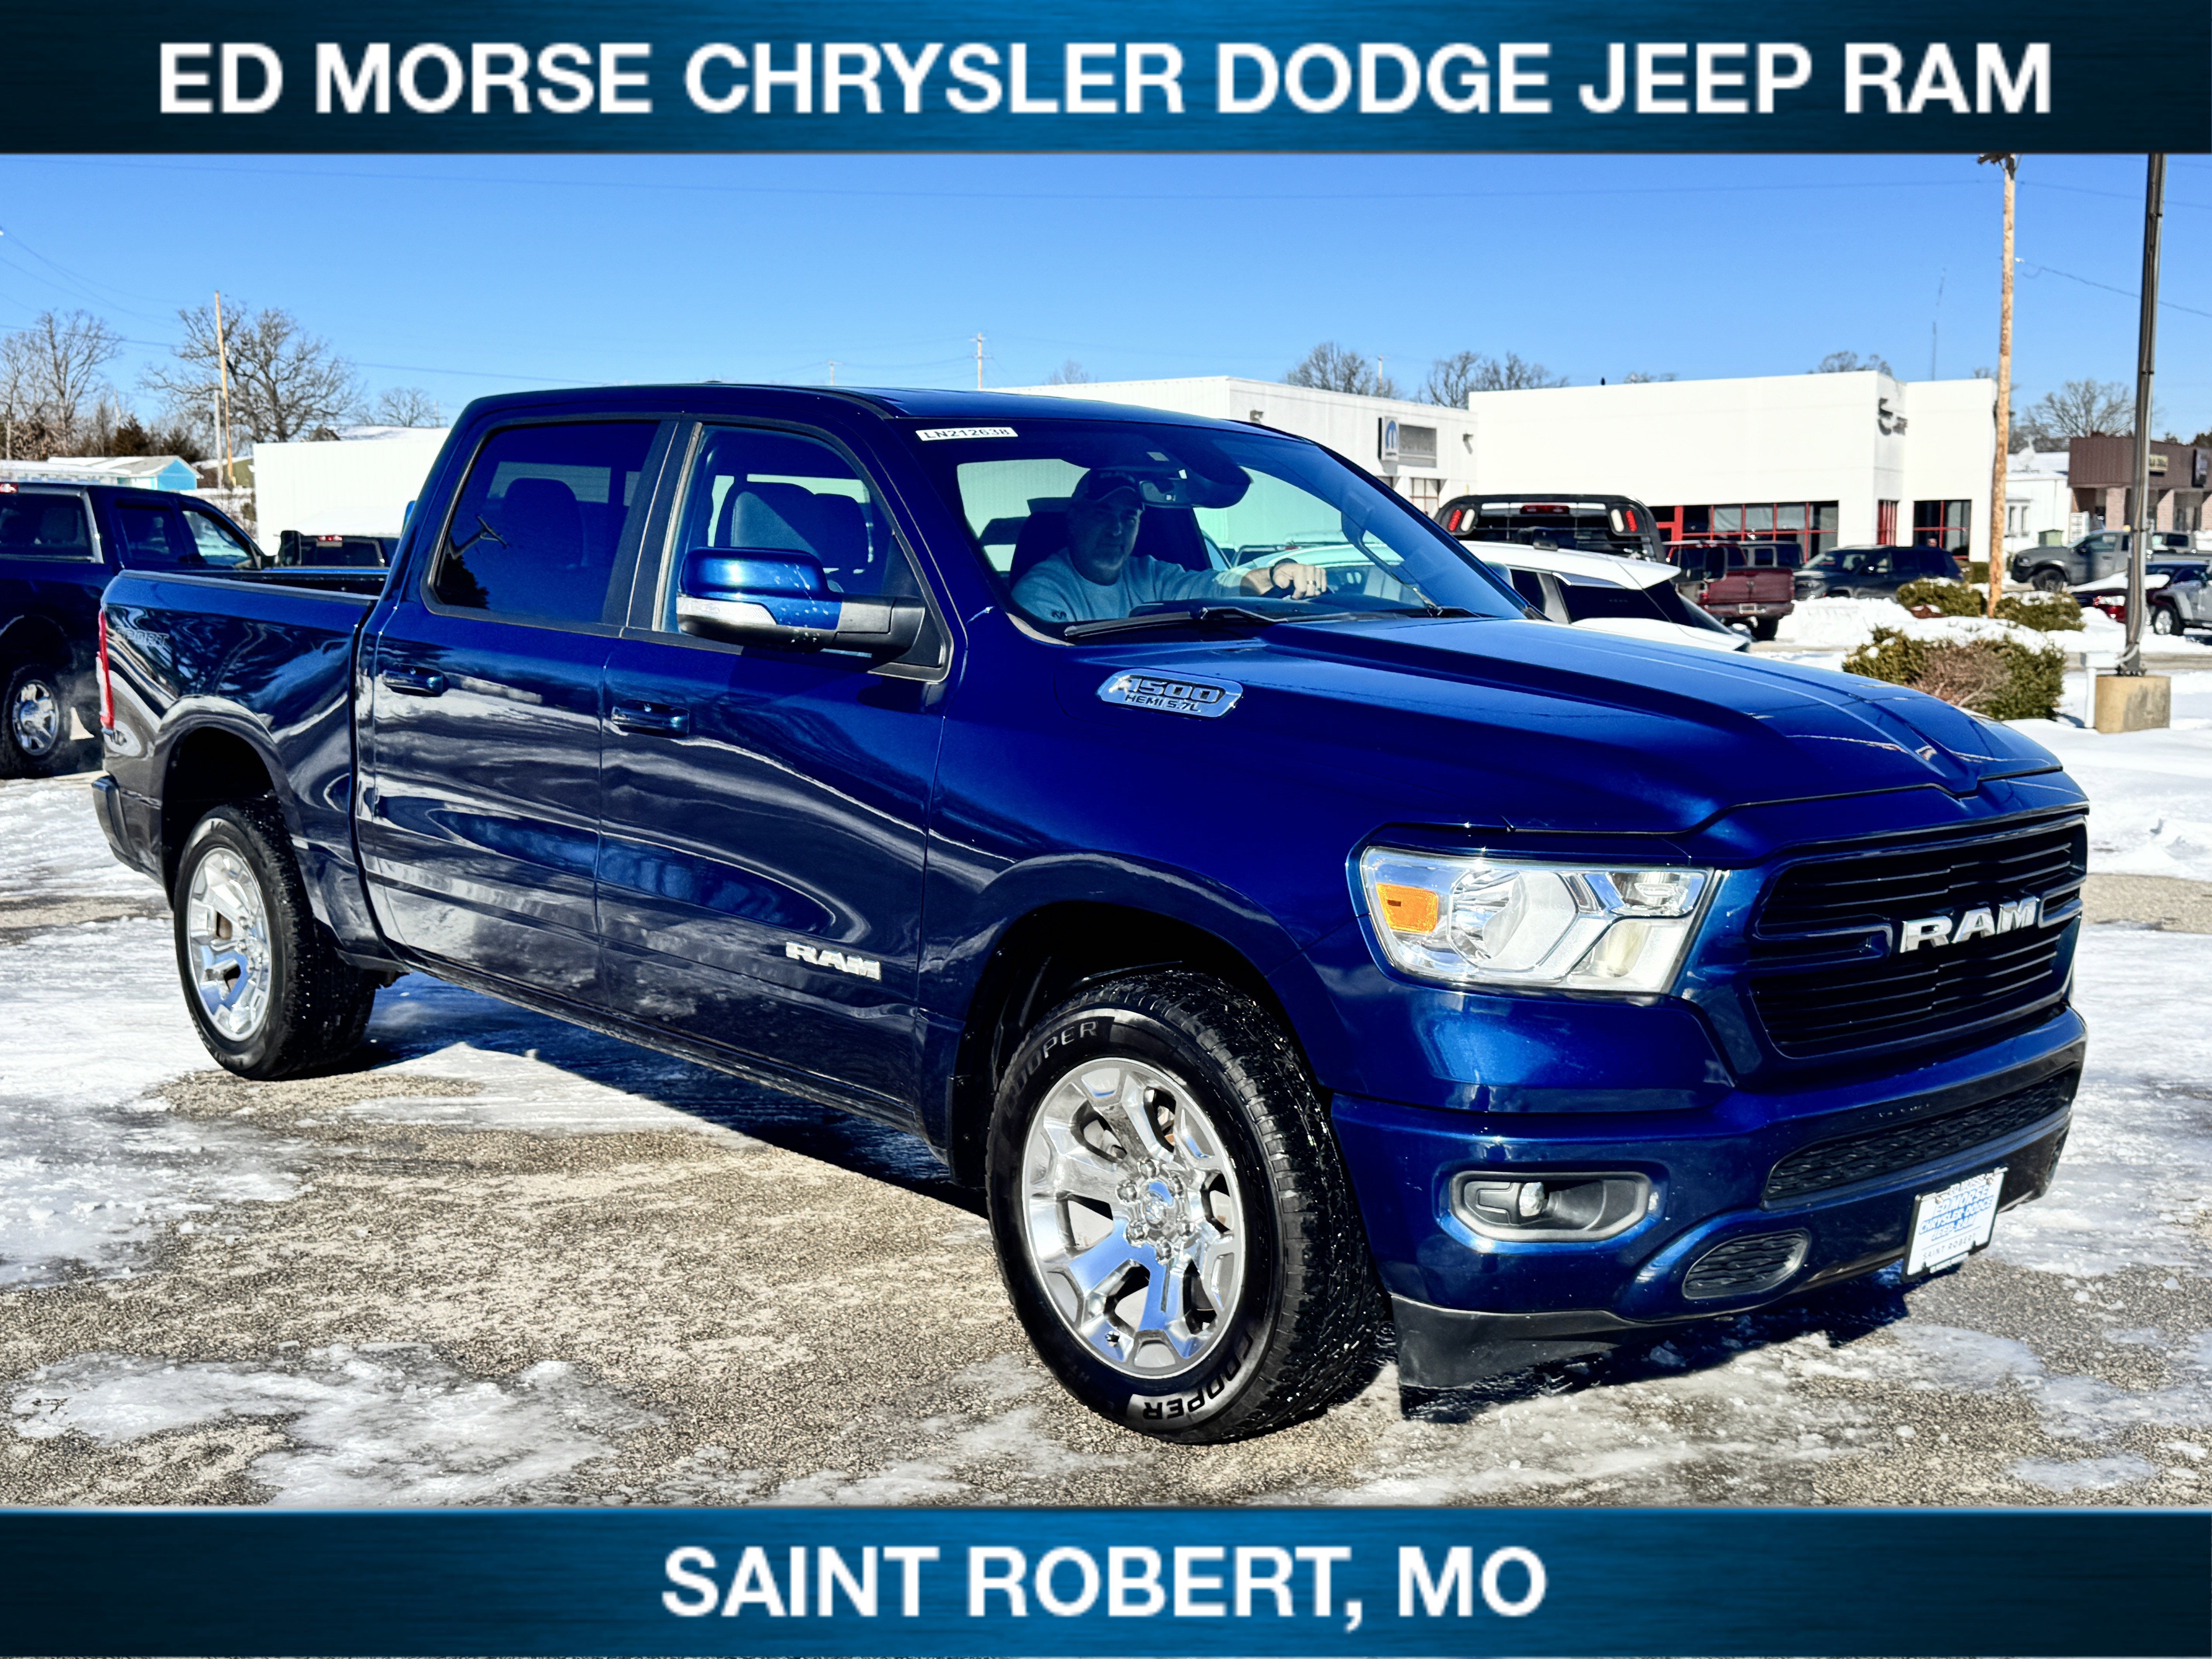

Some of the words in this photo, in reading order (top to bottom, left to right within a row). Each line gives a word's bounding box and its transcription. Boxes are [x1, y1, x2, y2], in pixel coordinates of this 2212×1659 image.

[1121, 677, 1222, 703] 1500
[1125, 693, 1162, 707] HEMI
[1166, 699, 1200, 713] 5.7L
[1900, 896, 2037, 953] RAM
[786, 941, 880, 981] RAM
[1934, 1200, 1951, 1215] ED
[1951, 1184, 1989, 1210] MORSE
[1923, 1245, 1945, 1260] SAINT
[1948, 1233, 1976, 1250] ROBERT
